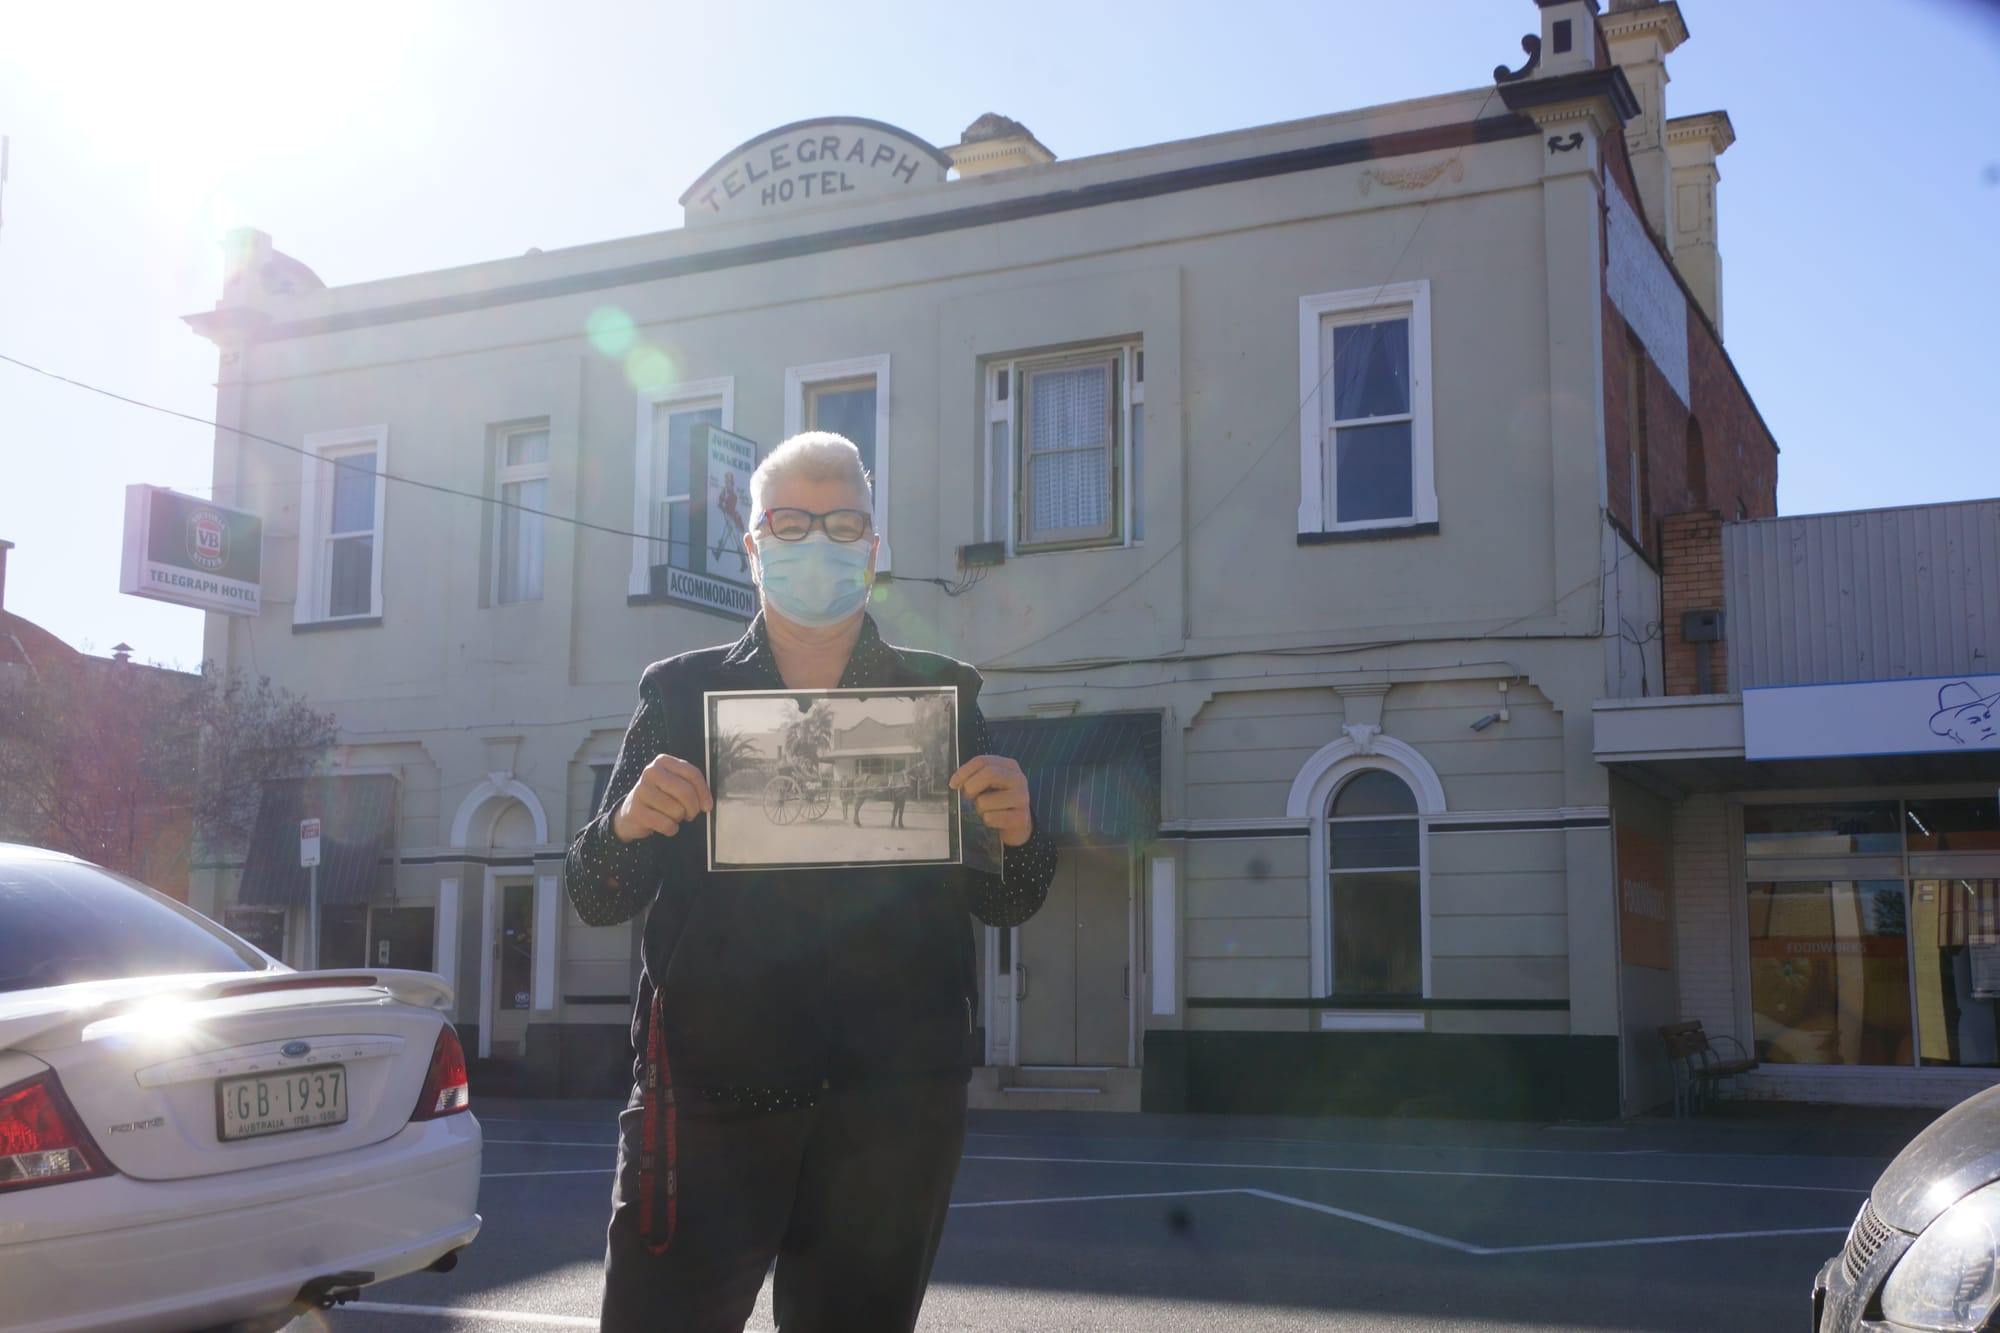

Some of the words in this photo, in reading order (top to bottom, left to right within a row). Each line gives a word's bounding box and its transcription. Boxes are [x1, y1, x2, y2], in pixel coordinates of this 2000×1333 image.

[701, 136, 920, 212] TELEGRAPH
[761, 171, 855, 206] HOTEL
[199, 530, 219, 548] VB
[150, 569, 218, 594] TELEGRAPH
[221, 585, 257, 602] HOTEL
[669, 572, 753, 612] ACCOMMODATION
[238, 1119, 285, 1134] AUSTRALIA
